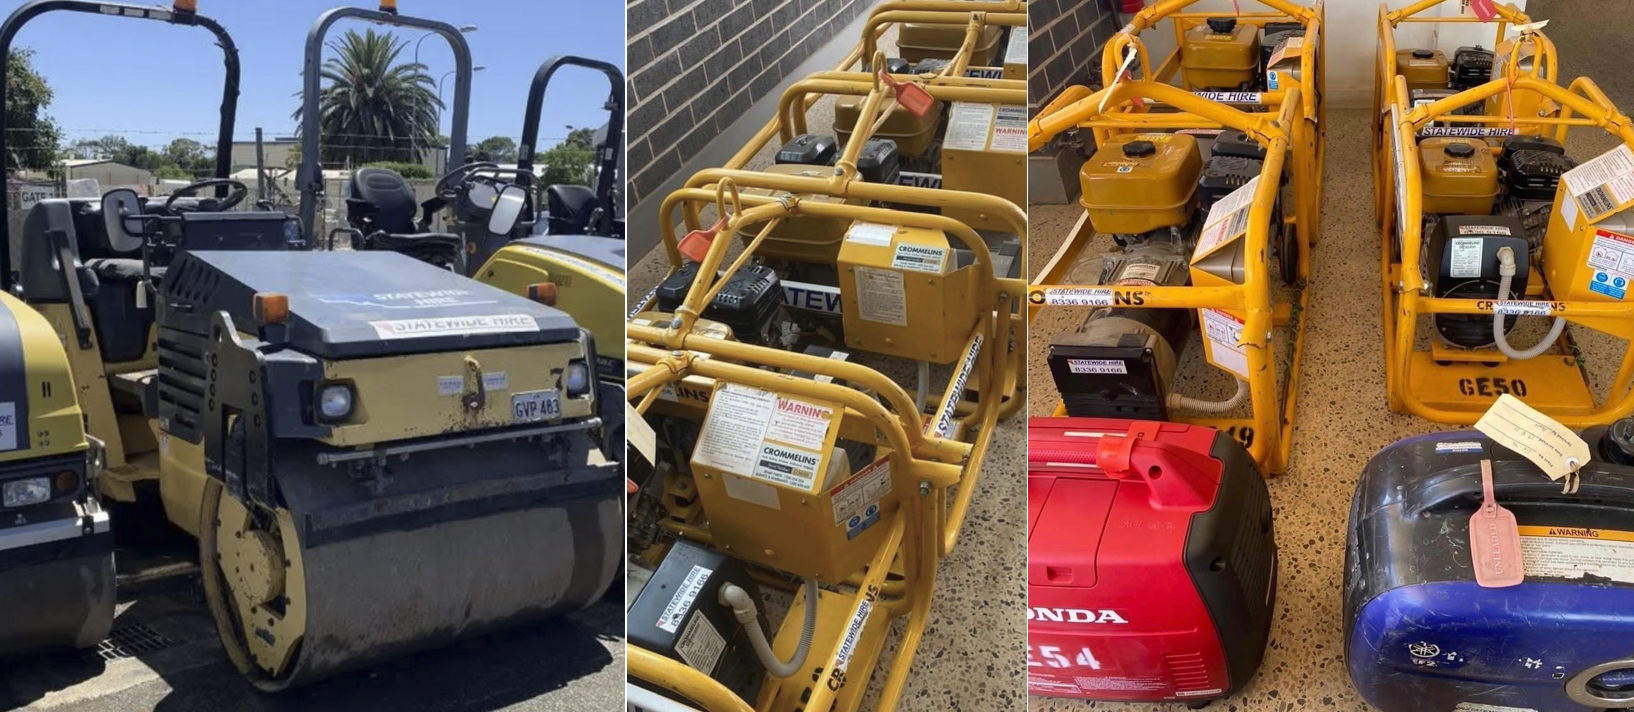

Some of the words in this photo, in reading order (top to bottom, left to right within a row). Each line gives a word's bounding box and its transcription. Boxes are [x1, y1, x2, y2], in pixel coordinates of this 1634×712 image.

[1228, 92, 1257, 101] HIRE
[995, 127, 1027, 136] WARNIN
[1423, 127, 1485, 136] STATEWIDE
[1489, 127, 1514, 136] HIRE
[22, 192, 46, 202] GATE
[898, 245, 944, 256] CROMMELINS
[373, 289, 475, 301] STATEWIDE
[1051, 298, 1079, 306] 8336
[393, 316, 488, 332] STATEWIDE
[493, 314, 532, 327] HIRE
[938, 363, 971, 432] STATEWIDE
[966, 335, 982, 363] HIRE
[1459, 377, 1527, 397] GE50
[515, 400, 538, 418] GVP
[763, 447, 817, 466] CROMMELINS
[1557, 527, 1600, 538] WARNING
[1489, 522, 1504, 576] UNLEADED
[661, 581, 689, 622] STATEWIDE
[687, 566, 701, 582] HIRE
[688, 572, 709, 598] 9166
[838, 618, 860, 661] STATEWIDE
[856, 600, 870, 619] HIRE
